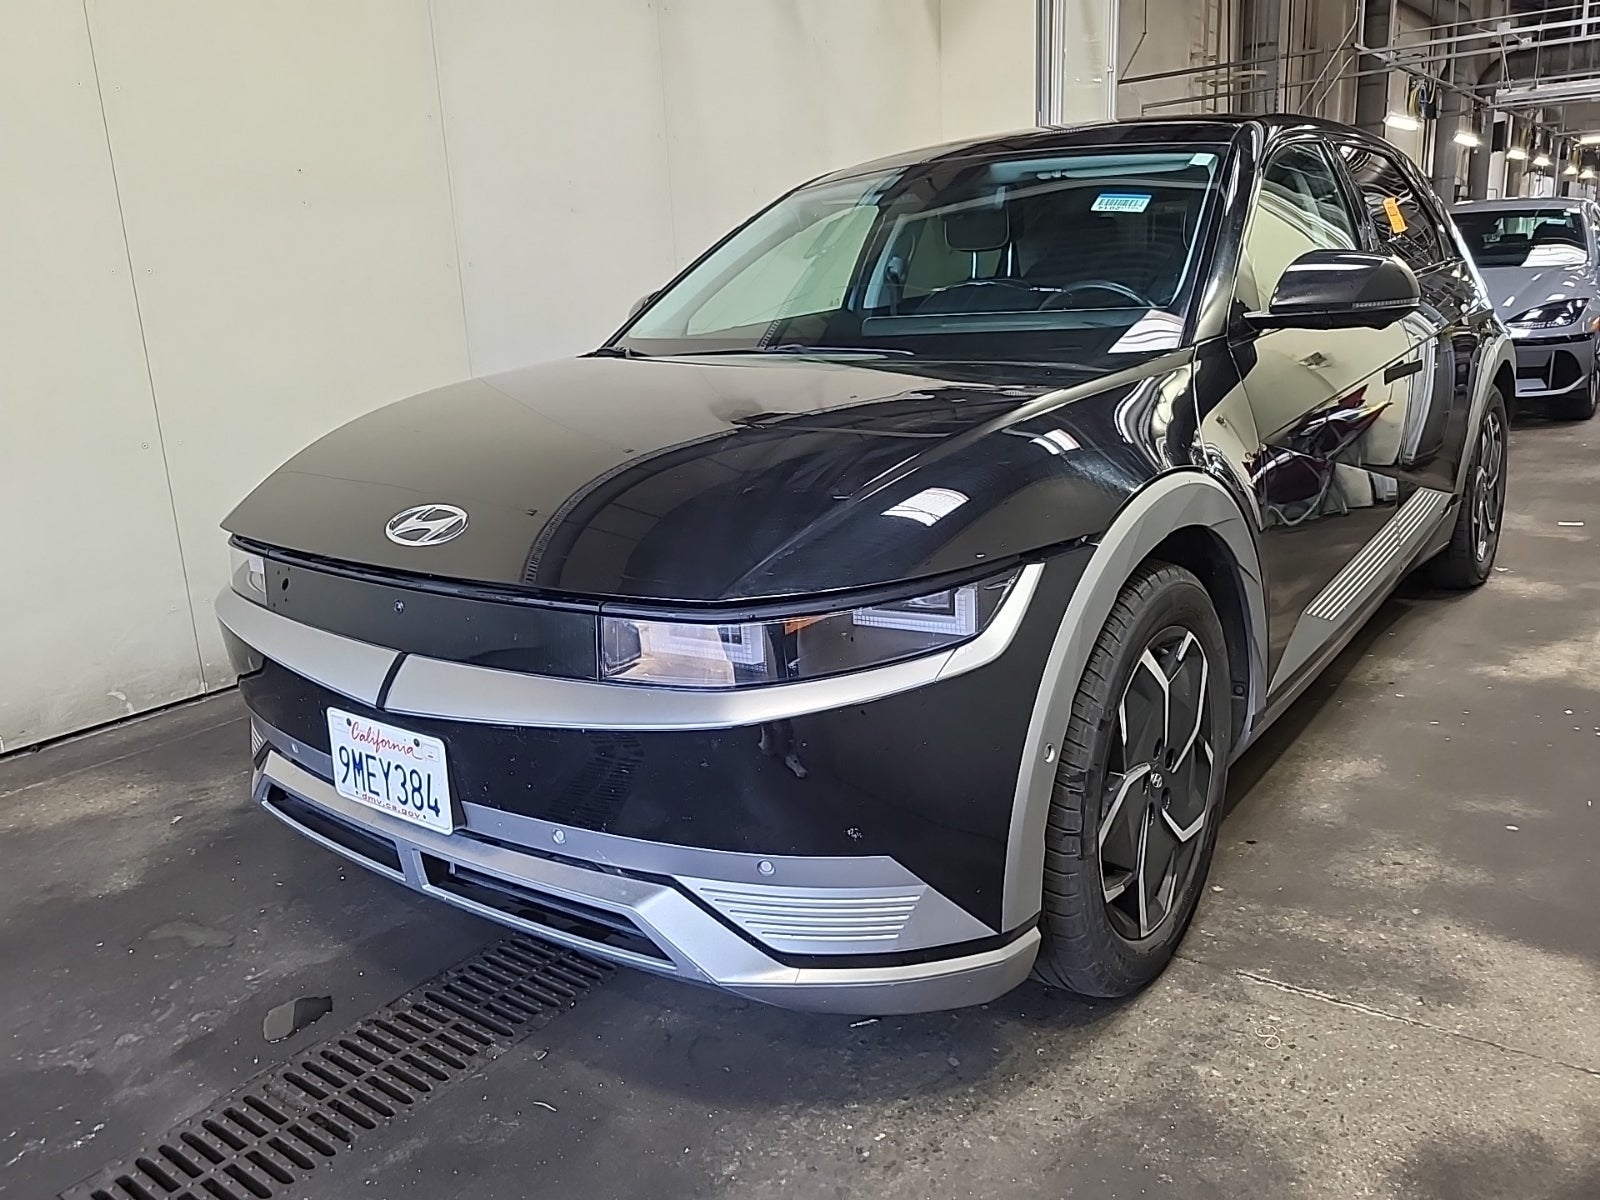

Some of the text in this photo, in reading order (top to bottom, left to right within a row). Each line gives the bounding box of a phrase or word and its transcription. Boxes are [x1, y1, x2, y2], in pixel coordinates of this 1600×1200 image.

[351, 721, 423, 760] California
[339, 746, 440, 817] 9MEY384
[362, 794, 420, 819] dmv.ca.gov
